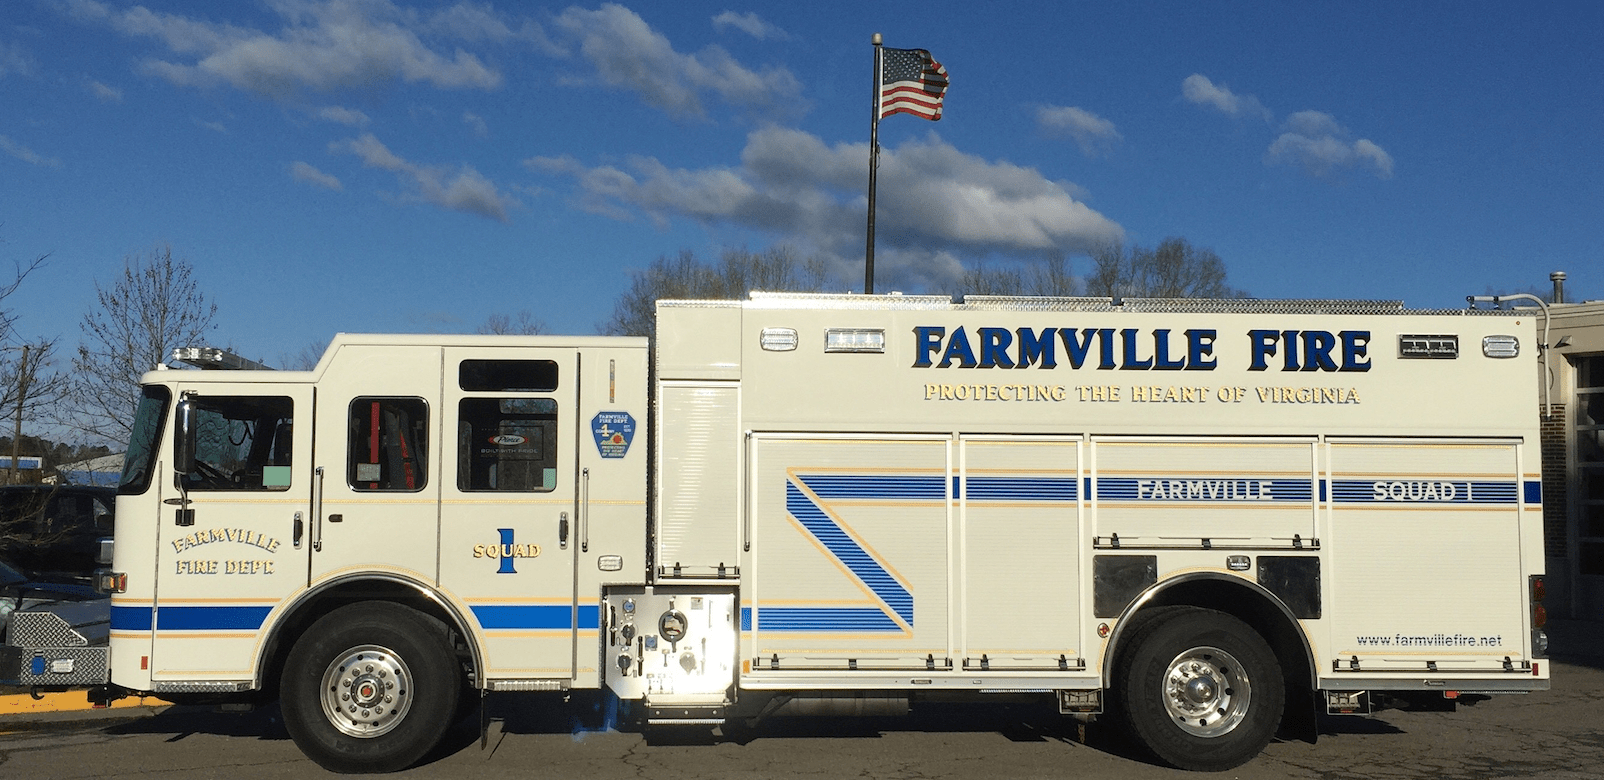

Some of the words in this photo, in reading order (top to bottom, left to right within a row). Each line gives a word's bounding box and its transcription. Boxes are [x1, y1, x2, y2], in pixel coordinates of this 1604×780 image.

[911, 325, 1218, 371] FARMVILLE
[1246, 329, 1372, 373] FIRE
[924, 383, 1066, 402] PROTECTING
[1075, 385, 1121, 403] THE
[1131, 385, 1210, 403] HEART
[1217, 386, 1247, 403] OF
[1255, 386, 1361, 404] VIRGINIA
[601, 423, 610, 437] 1
[1138, 480, 1273, 500] FARMVILLE
[1373, 481, 1456, 501] SQUAD
[171, 528, 281, 554] FARMVILLE
[473, 543, 541, 559] SQUAD
[496, 528, 518, 574] 1
[176, 559, 218, 574] FIRE
[1356, 633, 1502, 647] www.farmvillefire.net
